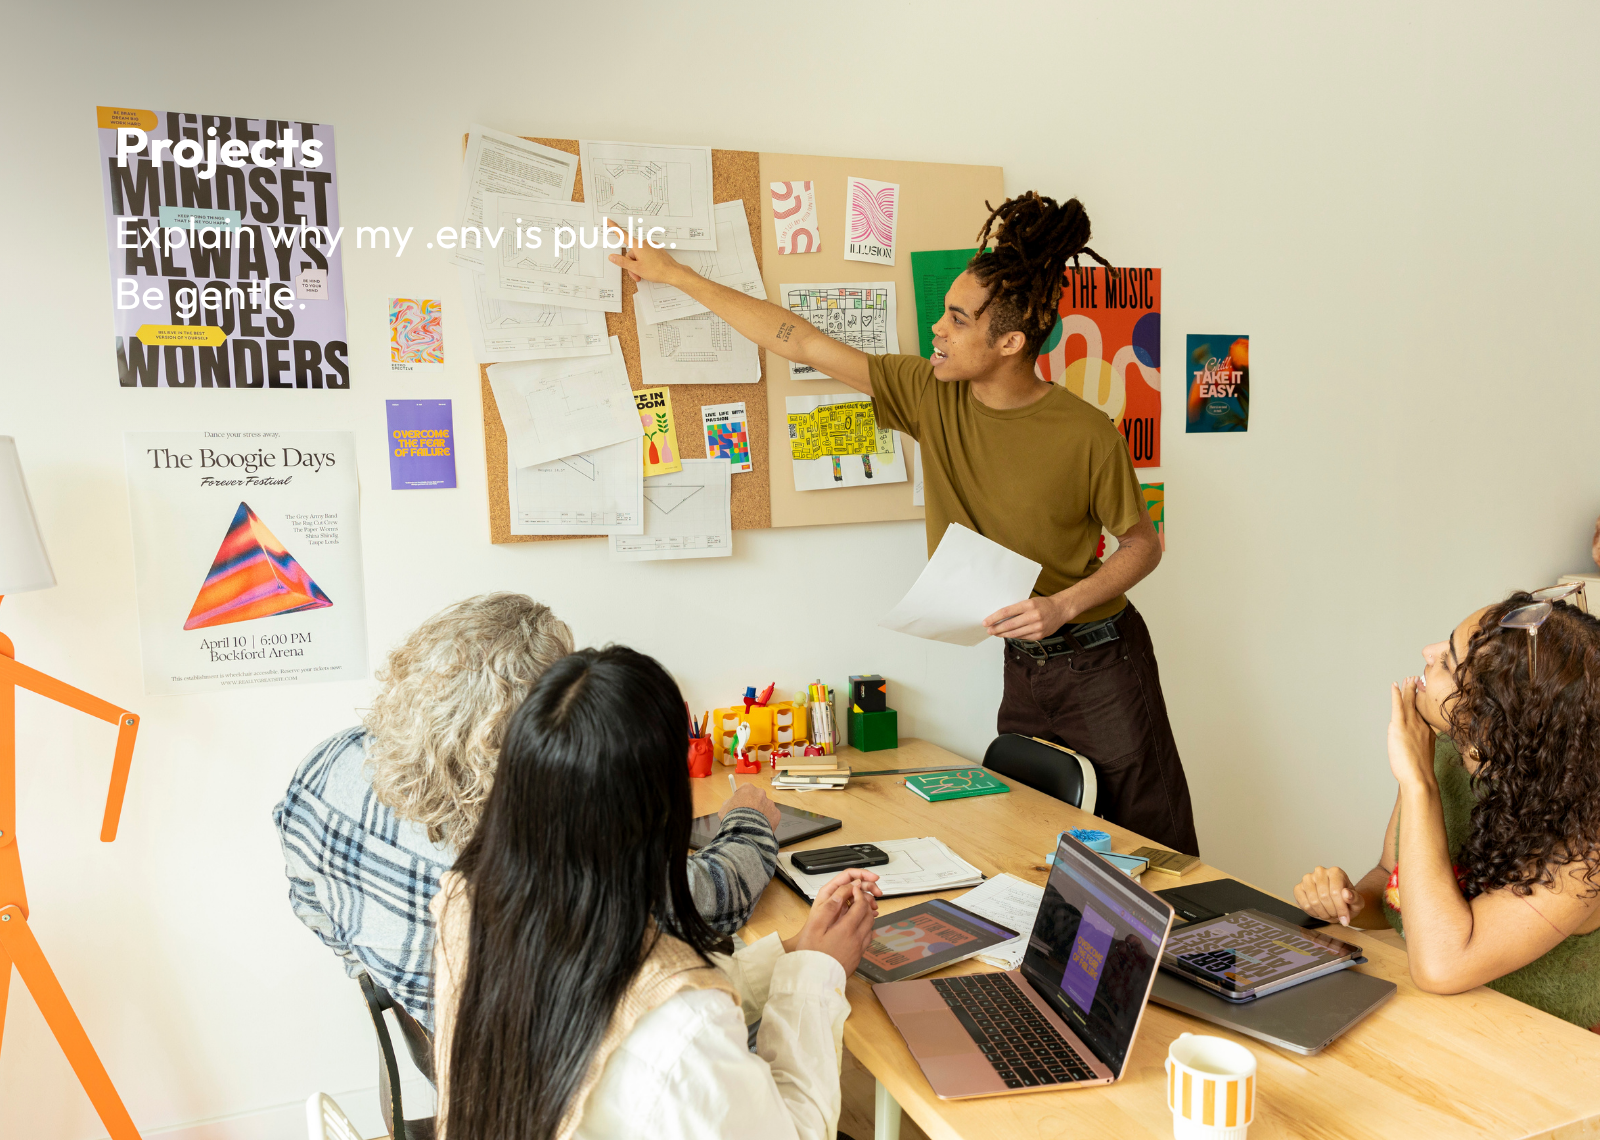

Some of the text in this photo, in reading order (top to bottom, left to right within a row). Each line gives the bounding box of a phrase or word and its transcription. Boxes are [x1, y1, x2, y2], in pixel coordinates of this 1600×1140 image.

[108, 157, 331, 226] MINDSET
[125, 218, 329, 281] ALWAYS
[850, 244, 892, 258] ILLUSION
[1069, 266, 1153, 309] THE MUSIC
[116, 336, 350, 389] WONDERS
[1204, 356, 1232, 373] Chill.
[1194, 371, 1243, 384] TAKE IT
[650, 392, 664, 400] IN
[1200, 384, 1238, 398] EASY.
[392, 430, 450, 439] OVERCOME
[1123, 418, 1154, 461] YOU
[398, 438, 445, 448] THE FEAR
[147, 447, 336, 473] The Boogie Days
[394, 447, 451, 457] OF FAILURE
[201, 475, 293, 487] Forever Festival
[200, 636, 230, 653] April
[233, 636, 247, 647] 10
[260, 634, 288, 646] 6:00
[291, 632, 312, 644] PM
[210, 647, 304, 662] Bockford Arena
[1077, 936, 1103, 964] OVERCOME
